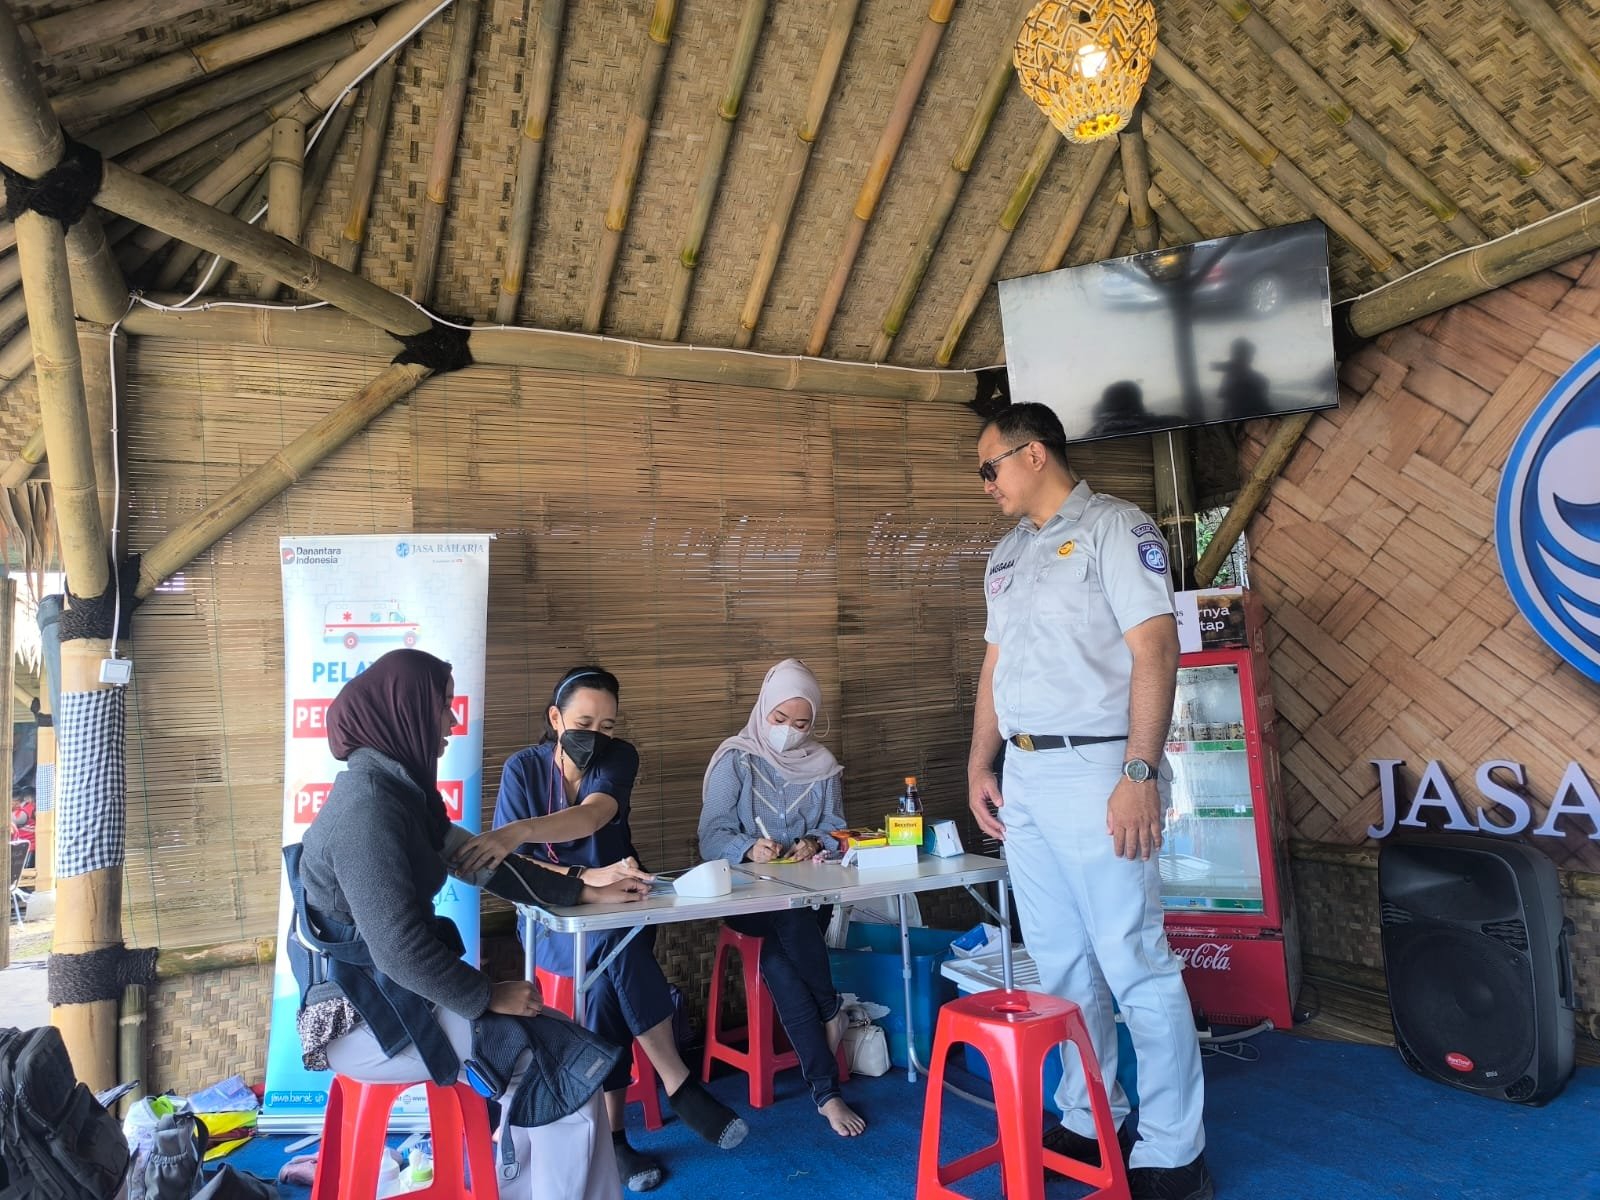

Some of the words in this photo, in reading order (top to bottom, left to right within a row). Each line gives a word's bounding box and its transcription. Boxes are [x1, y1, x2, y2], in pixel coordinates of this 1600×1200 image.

[296, 546, 341, 556] Danantara
[412, 543, 434, 555] JASA
[437, 543, 484, 554] RAHARJA
[296, 556, 338, 565] Indonesia
[1367, 759, 1600, 840] JASA
